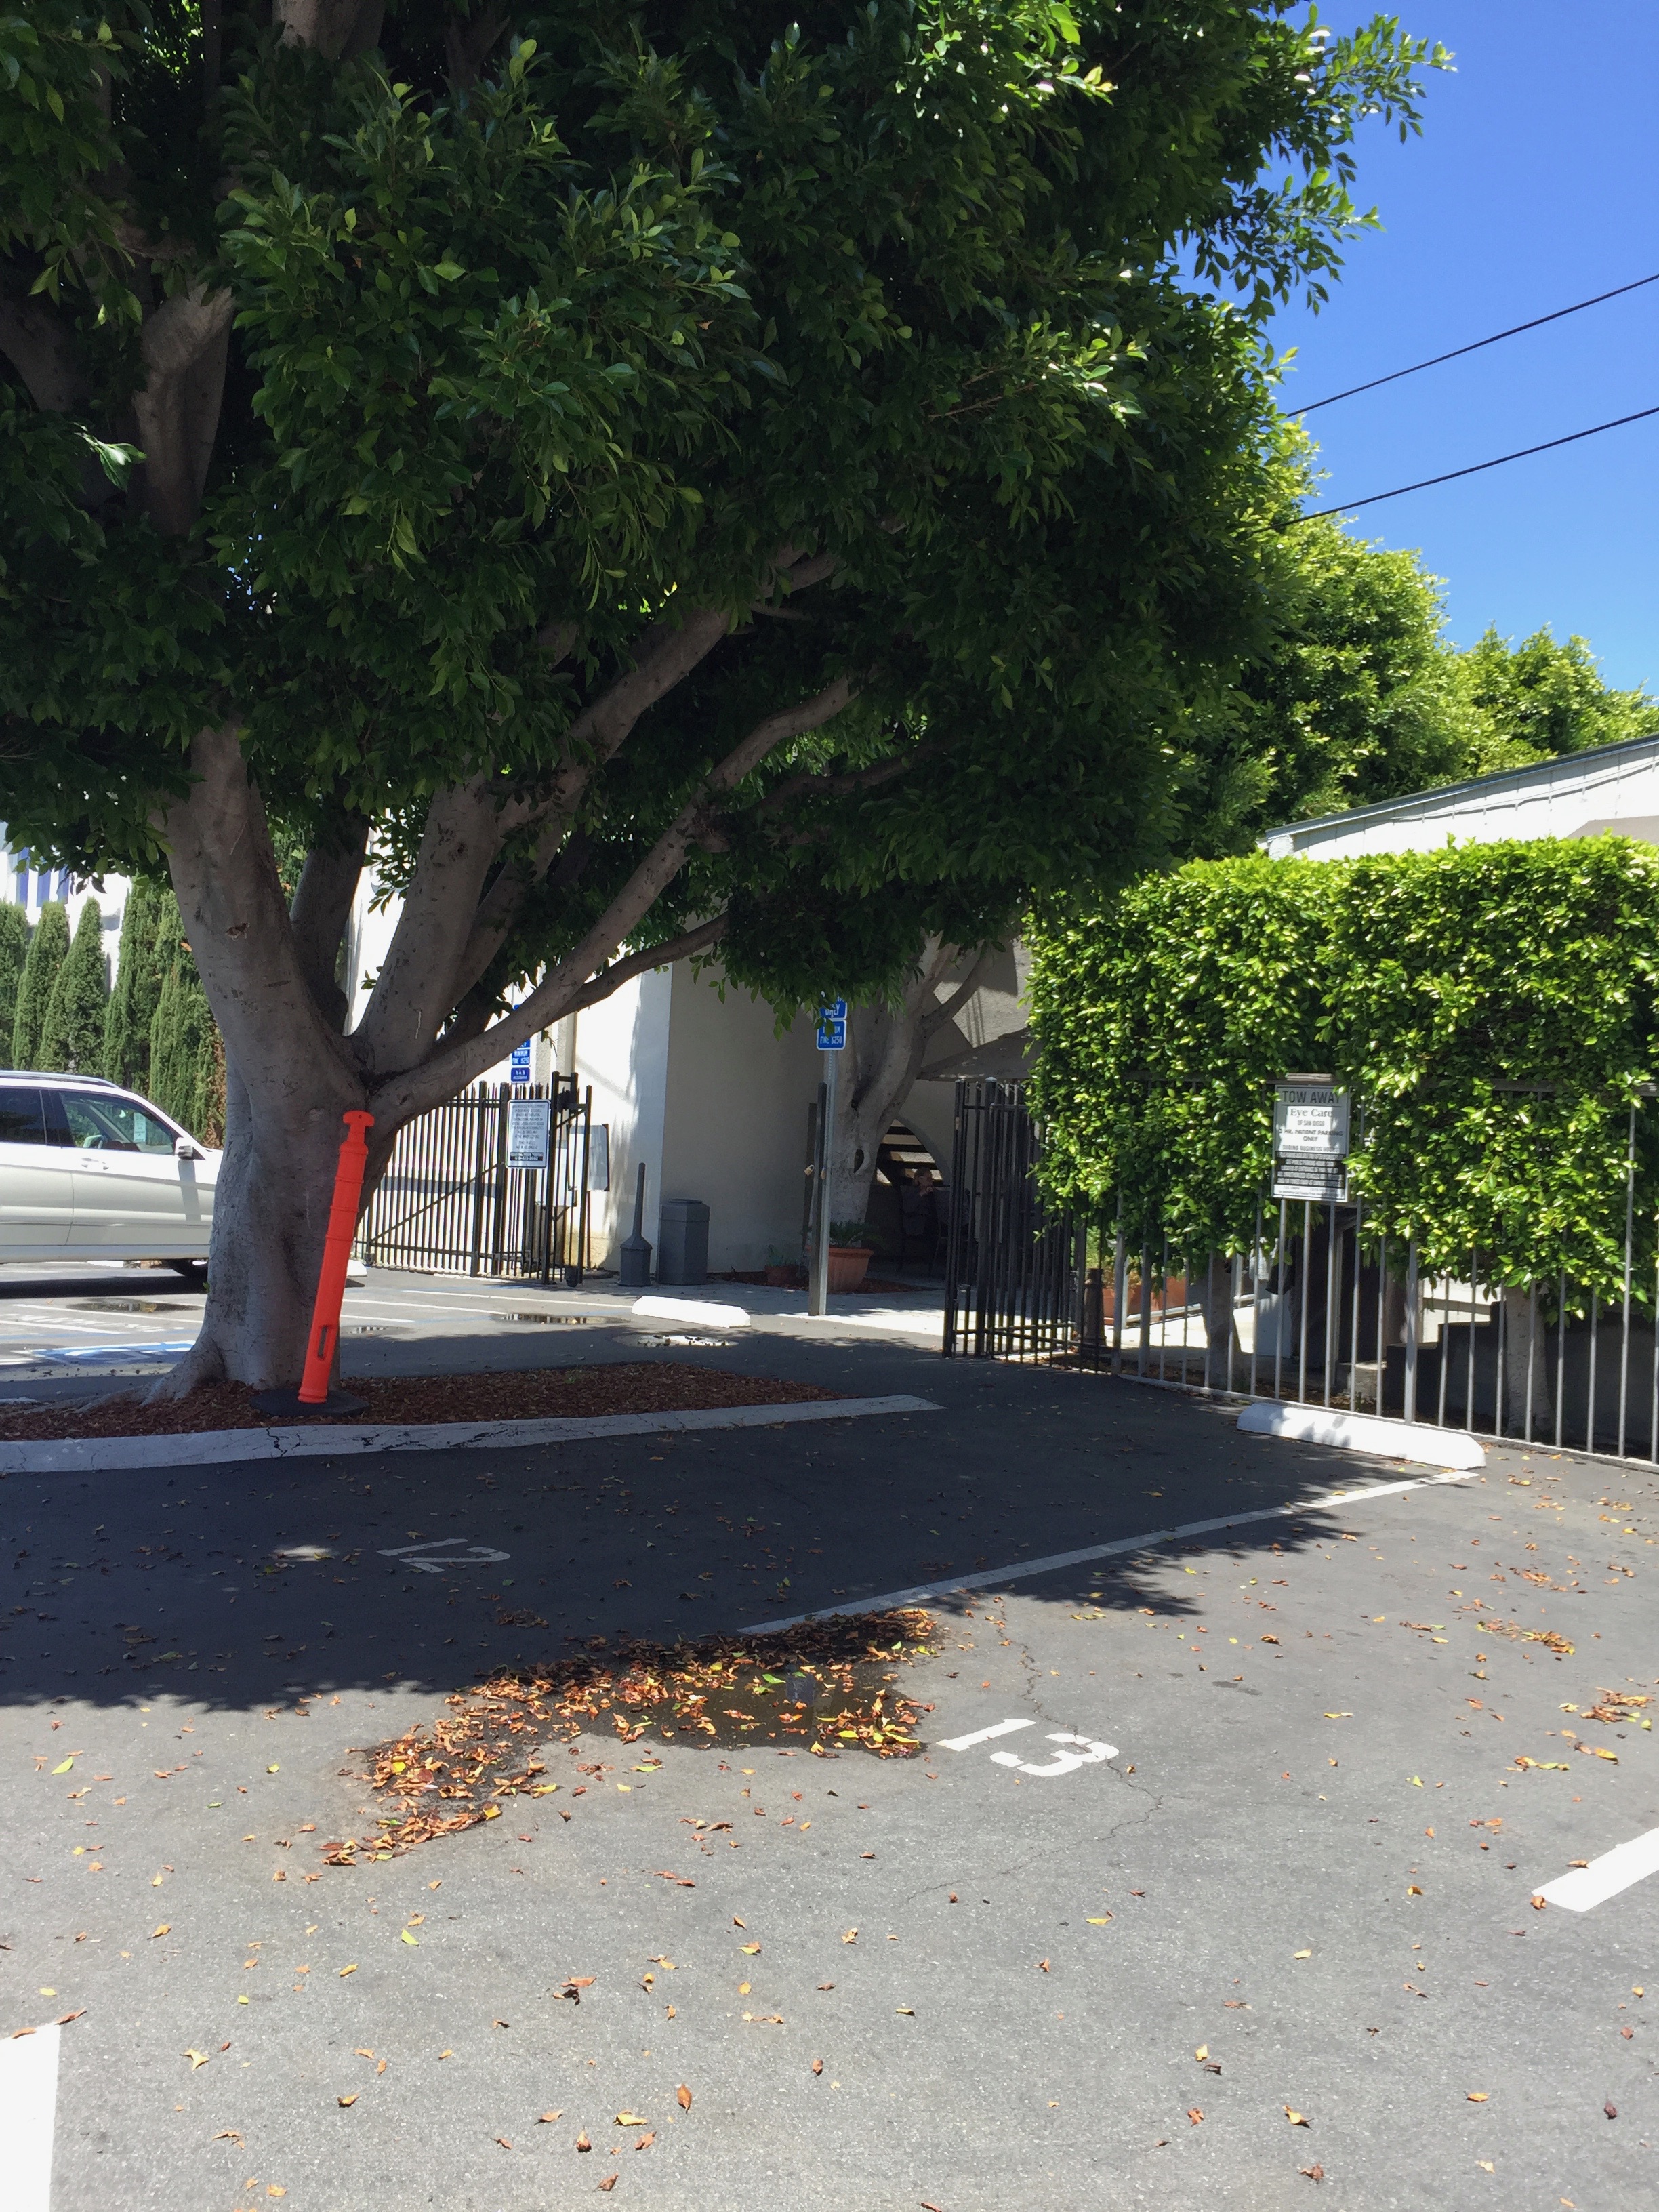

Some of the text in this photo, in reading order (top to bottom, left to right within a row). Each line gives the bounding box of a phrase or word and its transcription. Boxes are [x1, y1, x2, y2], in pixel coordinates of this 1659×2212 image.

[831, 1036, 842, 1044] $250
[1282, 1090, 1340, 1104] TOW AWAY
[1290, 1108, 1333, 1118] Eye Care
[376, 1538, 511, 1574] 12
[935, 1718, 1119, 1776] 13
